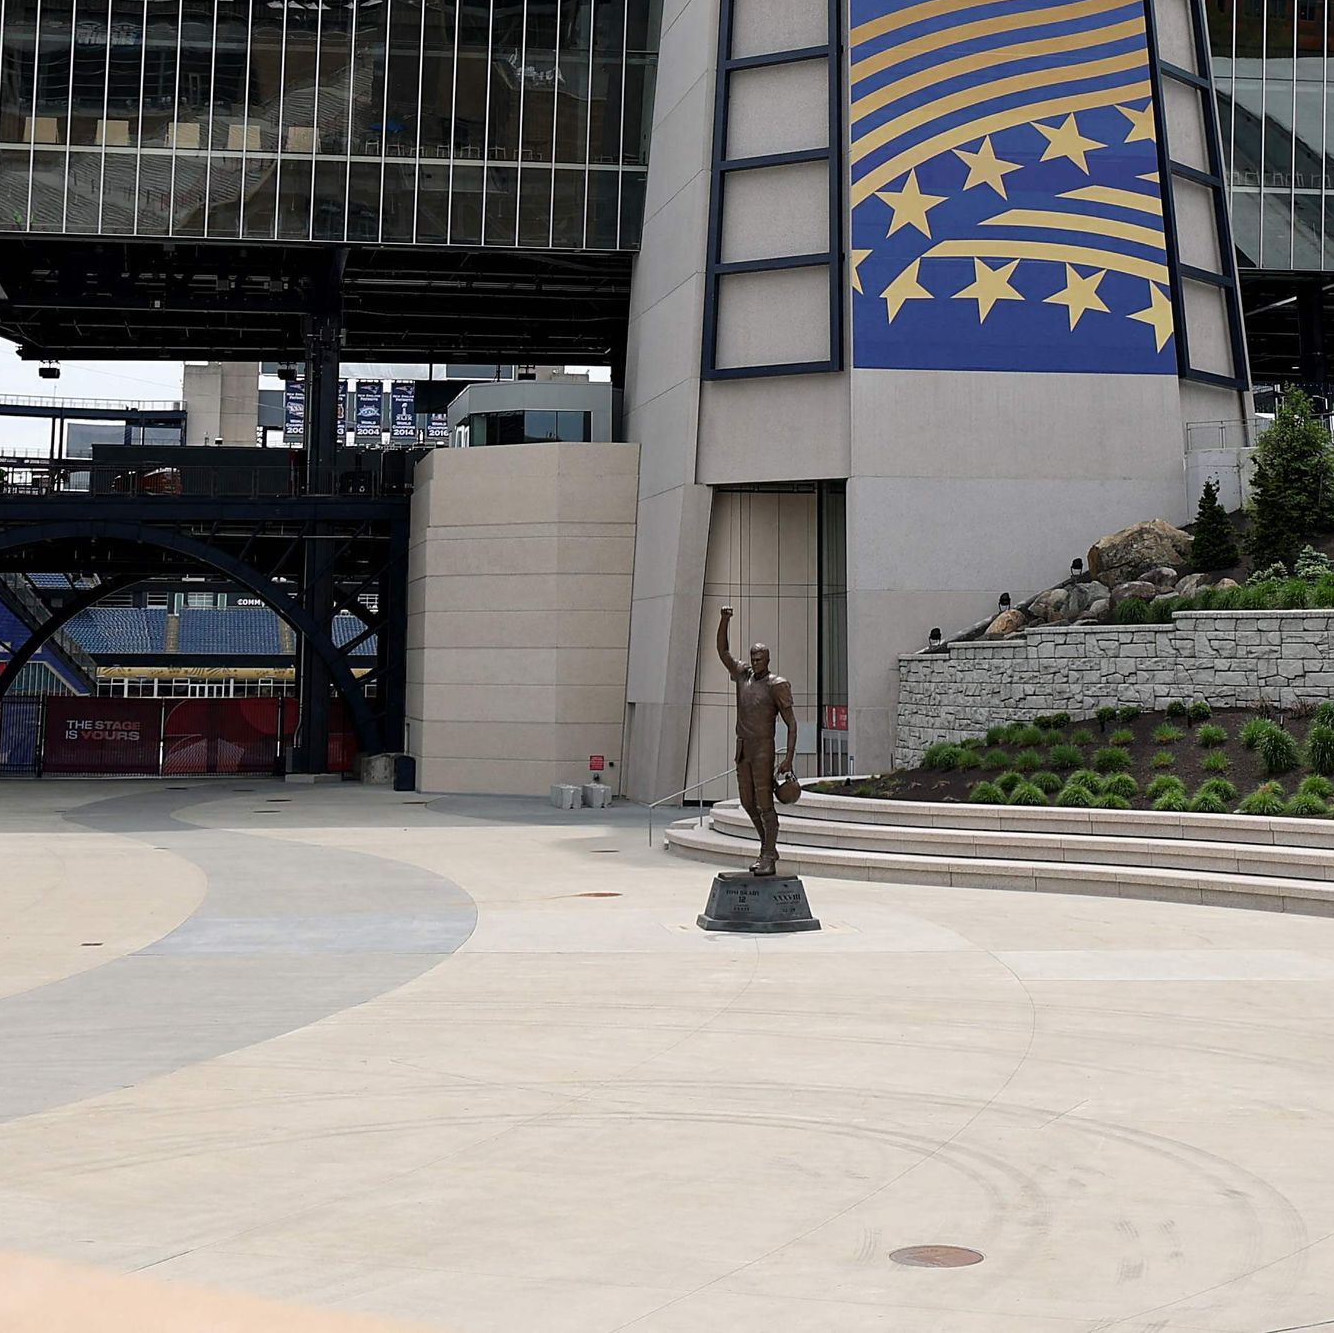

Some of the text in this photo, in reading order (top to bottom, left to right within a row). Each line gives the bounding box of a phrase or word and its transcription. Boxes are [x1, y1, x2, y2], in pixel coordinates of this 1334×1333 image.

[67, 720, 141, 731] THE STAGE
[65, 730, 141, 741] IS YOURS
